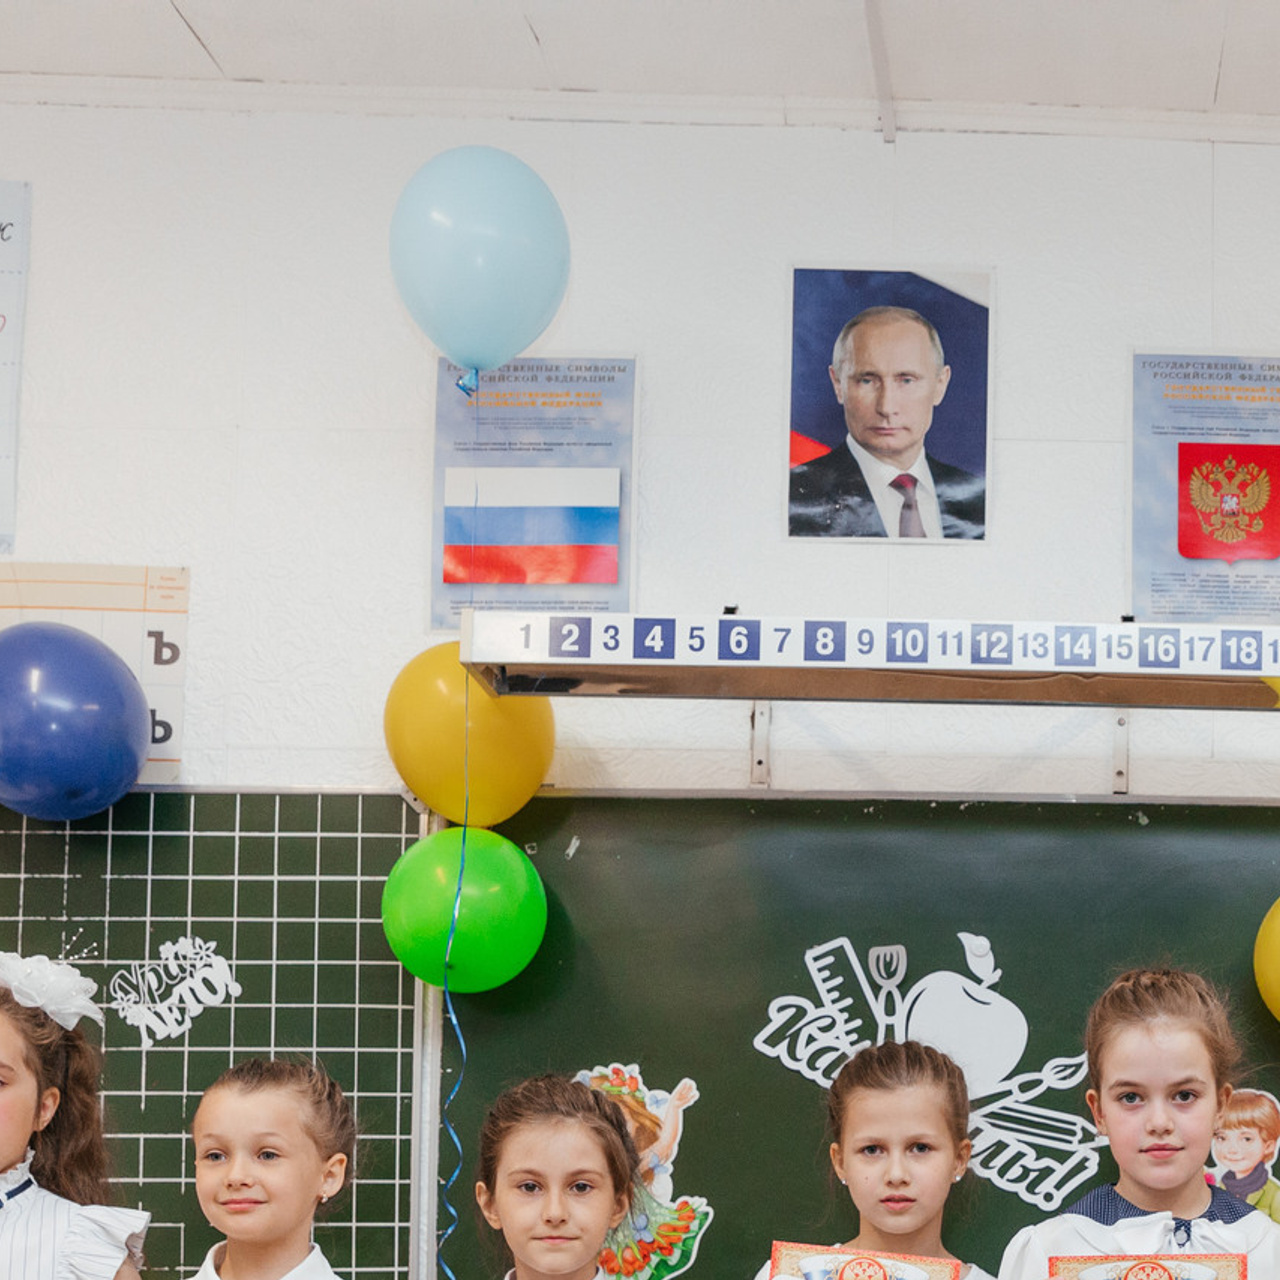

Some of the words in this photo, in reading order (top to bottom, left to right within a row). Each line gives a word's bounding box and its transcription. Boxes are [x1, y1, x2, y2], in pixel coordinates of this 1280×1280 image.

[568, 365, 627, 373] СИМВОЛЫ
[1142, 361, 1253, 371] ГОСУДАРСТВЕННЫЕ
[545, 375, 615, 383] ФЕДЕРАЦИИ
[1153, 372, 1233, 381] РОССИЙСКОЙ
[147, 631, 180, 665] Ъ
[519, 623, 532, 649] 1
[560, 623, 579, 652] 2
[602, 625, 620, 651] 3
[644, 624, 664, 653] 4
[688, 626, 706, 652] 5
[729, 626, 748, 655] 6
[773, 627, 792, 653] 7
[815, 626, 835, 656] 8
[856, 628, 875, 655] 9
[891, 628, 924, 657] 10
[936, 630, 965, 656] 11
[975, 630, 1008, 659] 12
[1017, 632, 1049, 659] 13
[1059, 632, 1091, 661] 14
[1101, 633, 1133, 660] 15
[1143, 633, 1176, 662] 16
[1183, 635, 1215, 662] 17
[1226, 635, 1258, 664] 18
